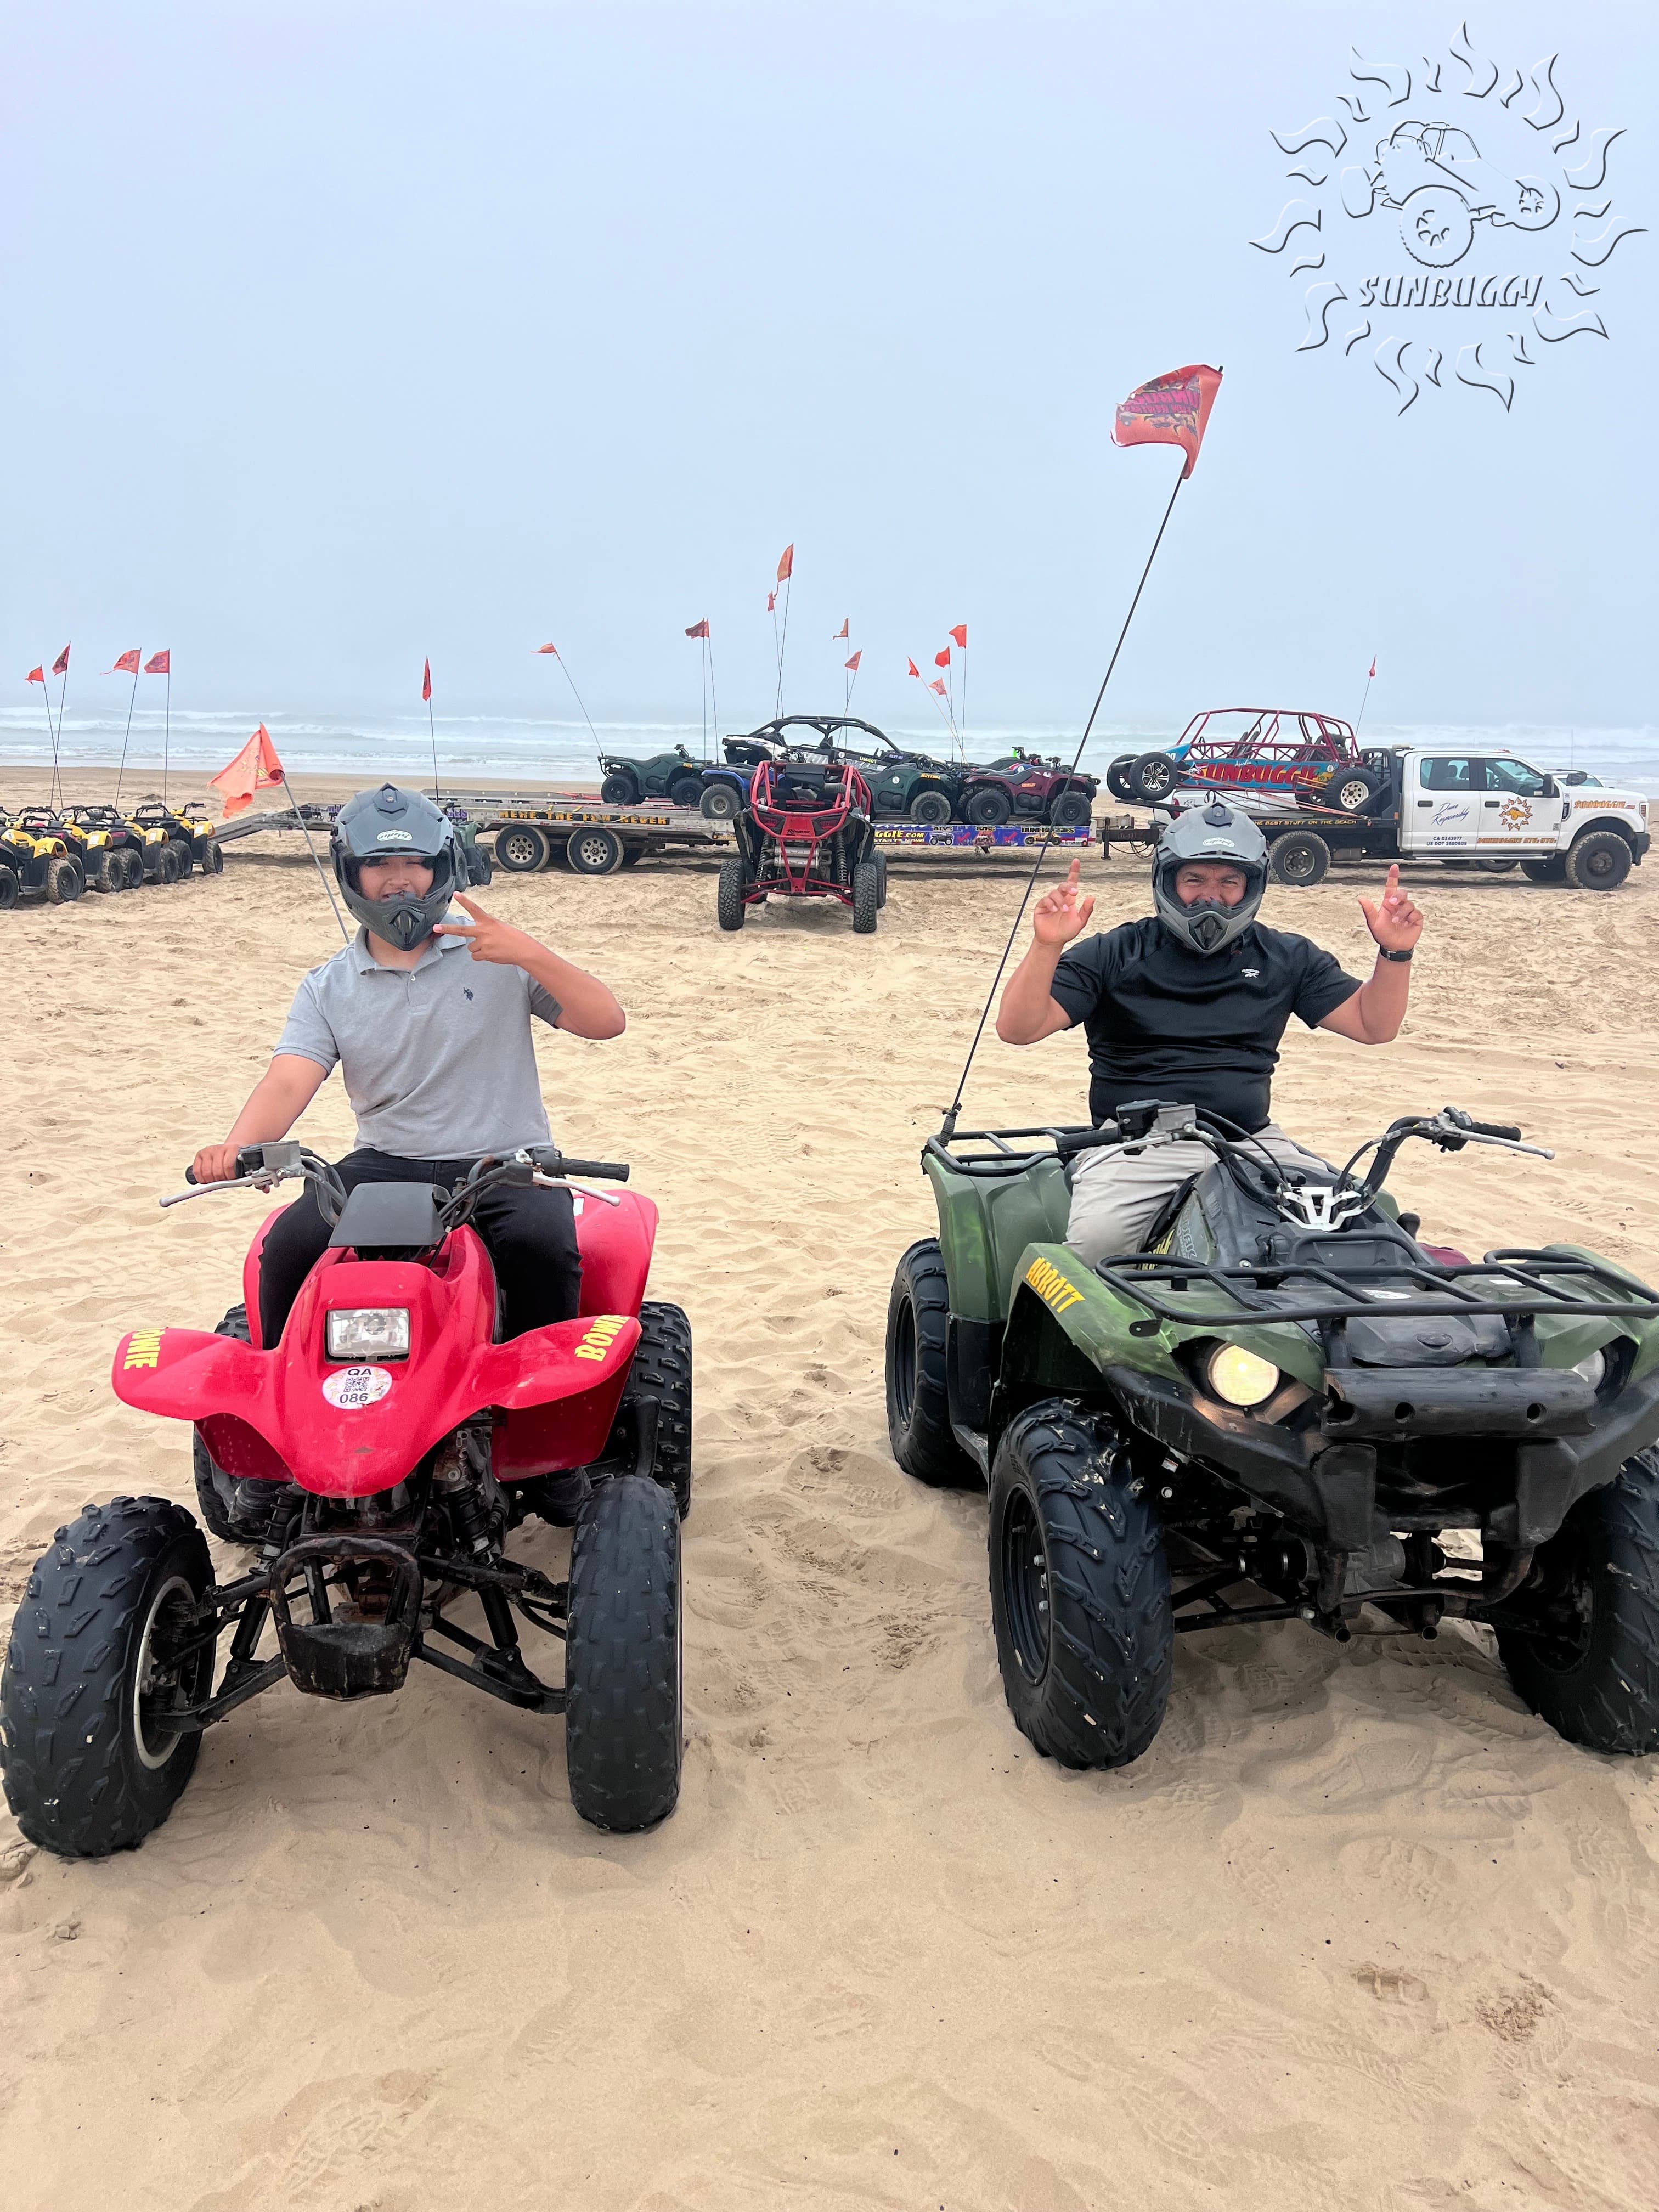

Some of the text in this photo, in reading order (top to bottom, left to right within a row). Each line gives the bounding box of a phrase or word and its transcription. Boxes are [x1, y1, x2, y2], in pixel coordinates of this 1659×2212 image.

[620, 815, 667, 825] NEVER
[1025, 1257, 1086, 1313] ABBOTT
[123, 1328, 166, 1370] OWIE
[340, 1393, 368, 1403] 086
